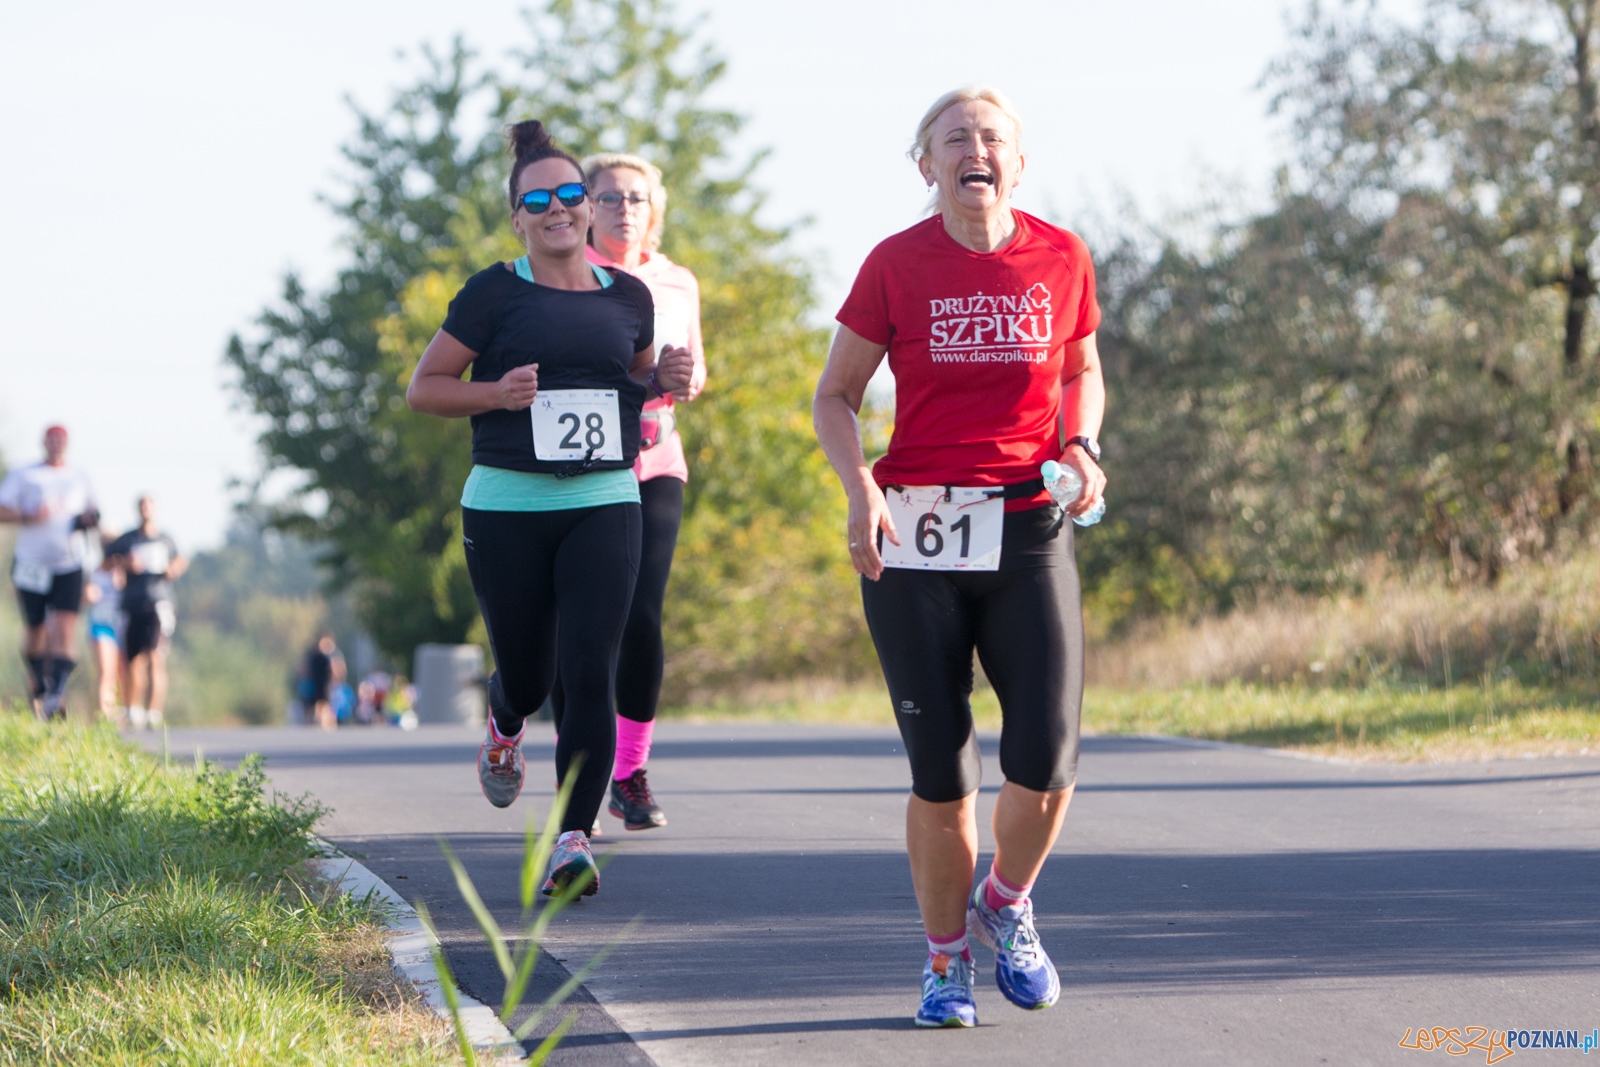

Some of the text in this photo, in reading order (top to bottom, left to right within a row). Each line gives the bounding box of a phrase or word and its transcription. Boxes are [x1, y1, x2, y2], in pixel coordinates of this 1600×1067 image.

[929, 291, 1034, 317] DRUŻYNA
[929, 314, 1053, 347] SZPIKU
[931, 349, 1048, 364] www.darszpiku.pl
[558, 412, 605, 449] 28
[915, 512, 971, 558] 61
